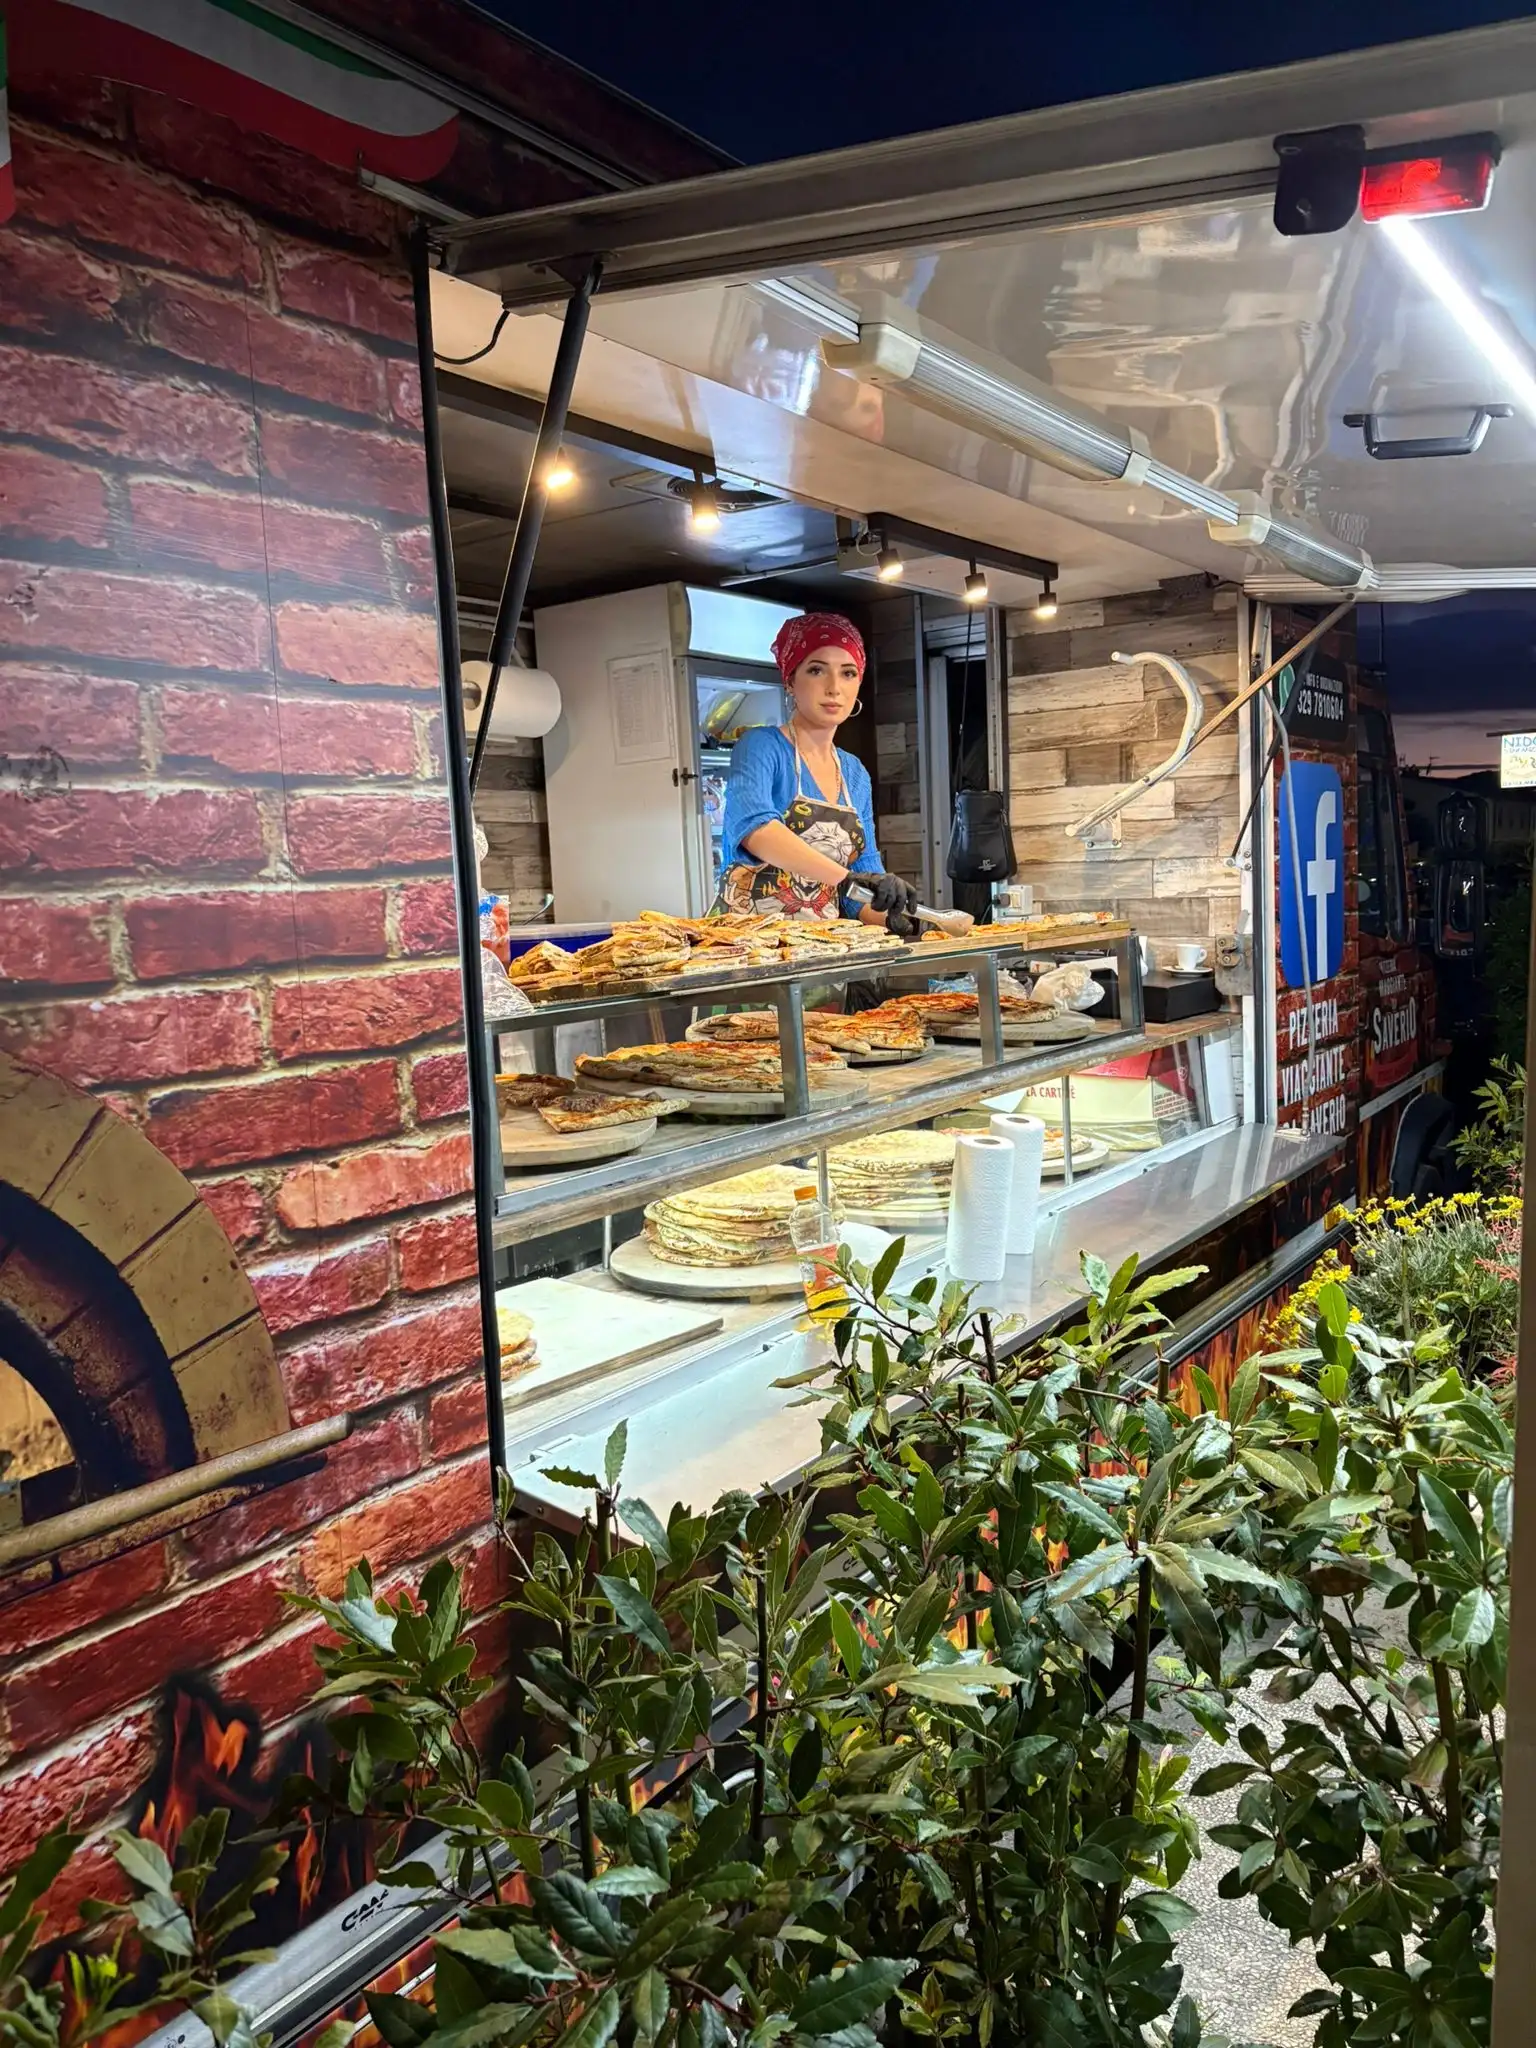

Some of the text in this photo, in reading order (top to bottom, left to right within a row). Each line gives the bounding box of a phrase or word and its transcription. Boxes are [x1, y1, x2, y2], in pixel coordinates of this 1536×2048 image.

[1297, 689, 1344, 721] 329 7810604
[1289, 998, 1339, 1050] PIZERIA
[1310, 1093, 1346, 1136] AVERIO
